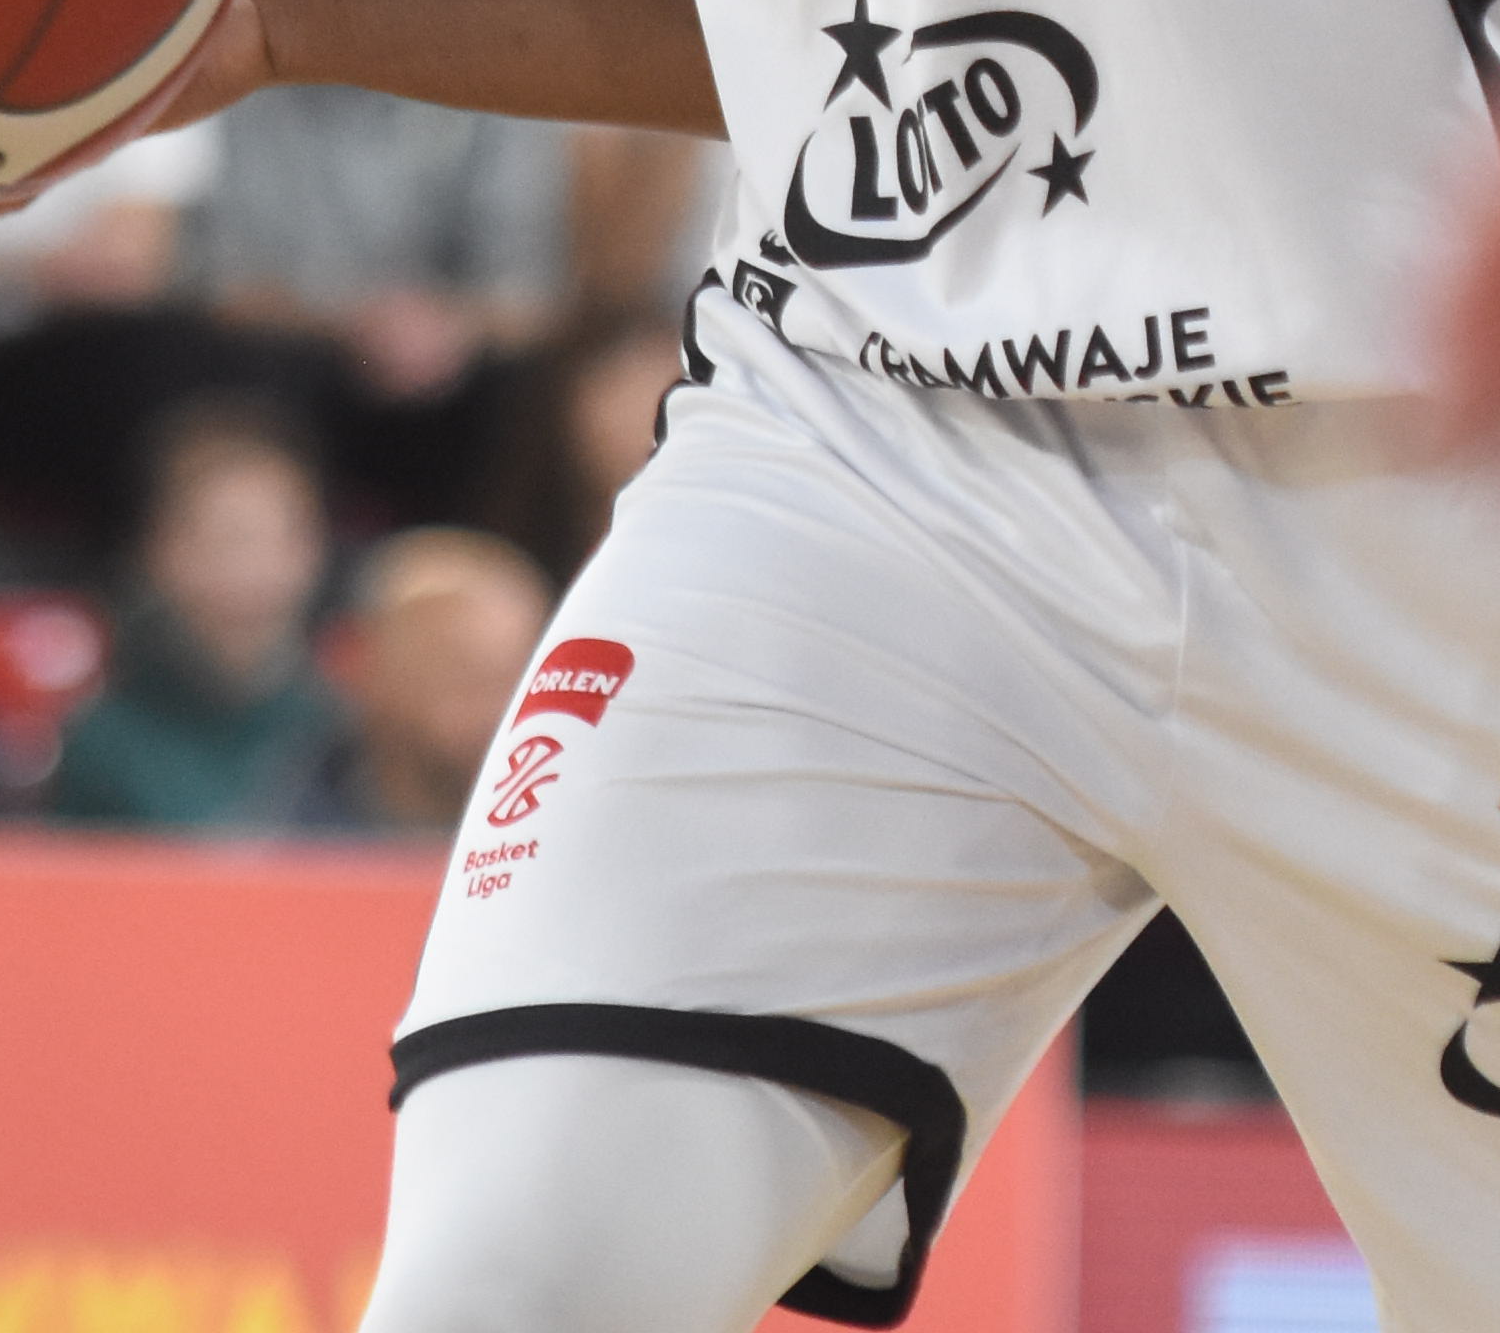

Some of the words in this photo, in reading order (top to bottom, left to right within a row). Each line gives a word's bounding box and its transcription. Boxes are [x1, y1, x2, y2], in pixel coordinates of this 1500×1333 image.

[850, 57, 1023, 222] LOTTO
[529, 669, 619, 697] ORLEN
[464, 839, 539, 874] Basket
[466, 871, 512, 900] Liga
